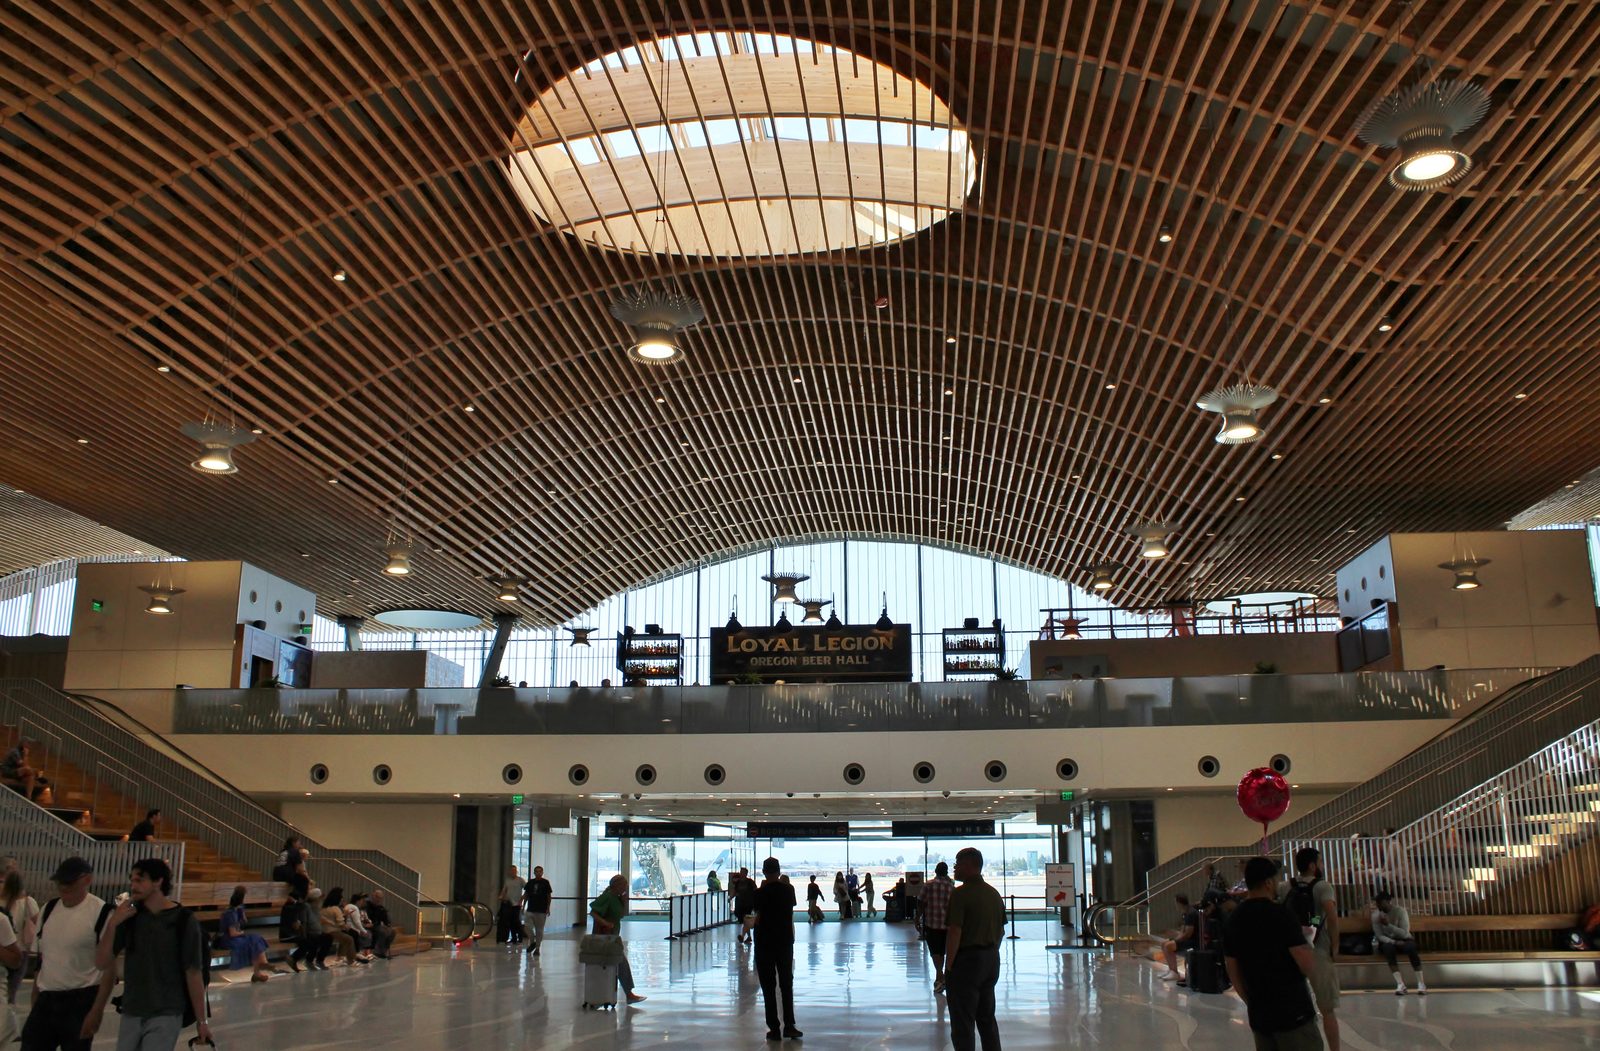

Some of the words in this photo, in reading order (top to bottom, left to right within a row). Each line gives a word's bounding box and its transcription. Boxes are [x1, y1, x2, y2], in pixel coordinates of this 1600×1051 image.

[727, 635, 806, 653] LOYAL
[813, 634, 894, 652] LEGION
[750, 655, 798, 666] OREGON
[802, 655, 832, 665] BEER
[836, 654, 869, 665] HALL
[512, 795, 523, 804] EXIT
[1062, 791, 1073, 801] EXIT
